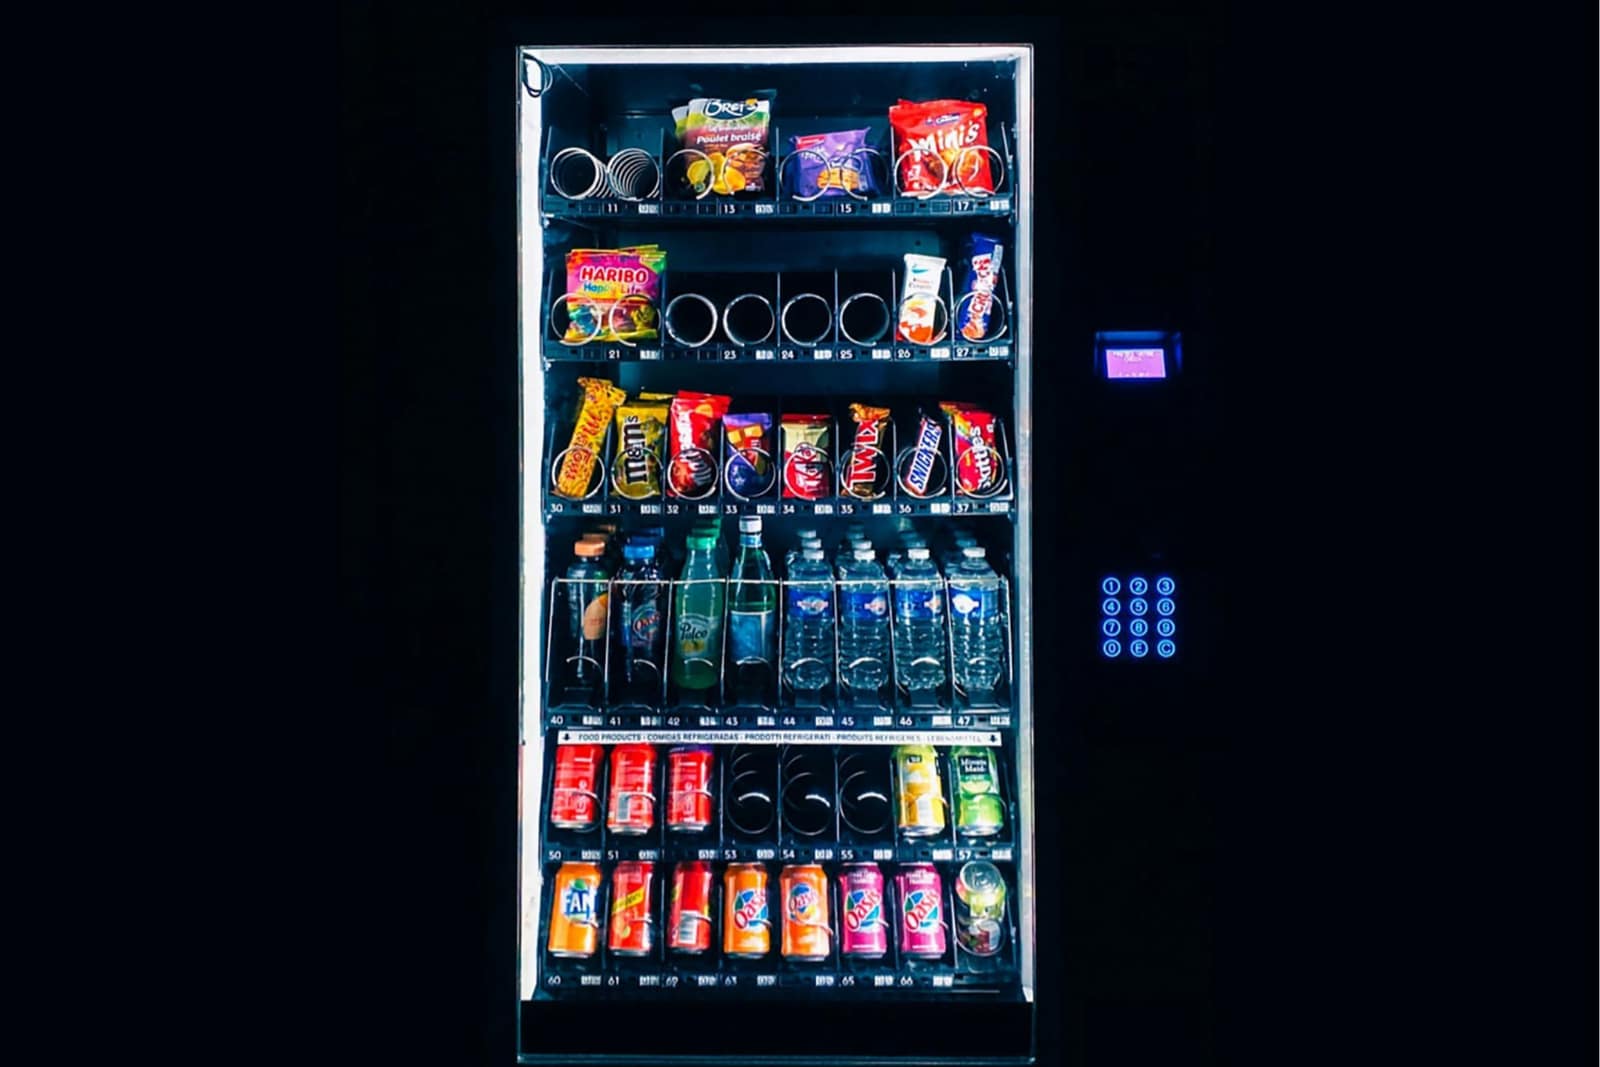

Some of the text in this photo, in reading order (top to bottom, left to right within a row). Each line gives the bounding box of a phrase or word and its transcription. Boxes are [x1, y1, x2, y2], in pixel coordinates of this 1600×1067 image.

[696, 133, 729, 145] Poulet
[608, 204, 618, 213] 11
[724, 204, 736, 213] 13
[840, 204, 852, 213] 15
[957, 202, 969, 211] 17
[581, 266, 648, 284] HARIBO
[609, 351, 620, 360] 21
[724, 351, 736, 360] 23
[782, 351, 794, 360] 24
[840, 351, 852, 360] 25
[898, 350, 911, 360] 26
[957, 349, 969, 358] 27
[846, 420, 879, 490] TWIX
[551, 504, 562, 513] 30
[610, 504, 620, 513] 31
[667, 504, 679, 513] 32
[725, 504, 737, 513] 33
[783, 504, 795, 513] 34
[841, 504, 853, 513] 35
[899, 504, 911, 513] 36
[957, 503, 969, 513] 37
[551, 716, 563, 725] 40
[609, 717, 621, 725] 41
[667, 717, 680, 726] 42
[725, 717, 738, 726] 43
[783, 717, 795, 726] 44
[841, 717, 854, 726] 45
[900, 716, 912, 726] 46
[957, 716, 970, 726] 47
[578, 733, 600, 742] FOOD
[601, 733, 641, 742] PRODUCTS
[647, 733, 681, 742] COMIDAS
[683, 733, 739, 742] REFRIGERADAS
[744, 733, 782, 742] PRODOTTI
[783, 733, 831, 742] REFRIGERATI
[836, 733, 873, 742] PRODUITS
[549, 851, 561, 860] 50
[608, 851, 619, 860] 51
[724, 850, 737, 860] 53
[783, 850, 795, 859] 54
[841, 850, 853, 859] 55
[959, 849, 971, 859] 57
[847, 890, 880, 930] Oasis
[906, 890, 939, 930] Oasis
[548, 975, 561, 985] 60
[608, 975, 619, 985] 61
[842, 976, 854, 985] 65
[900, 976, 913, 985] 66
